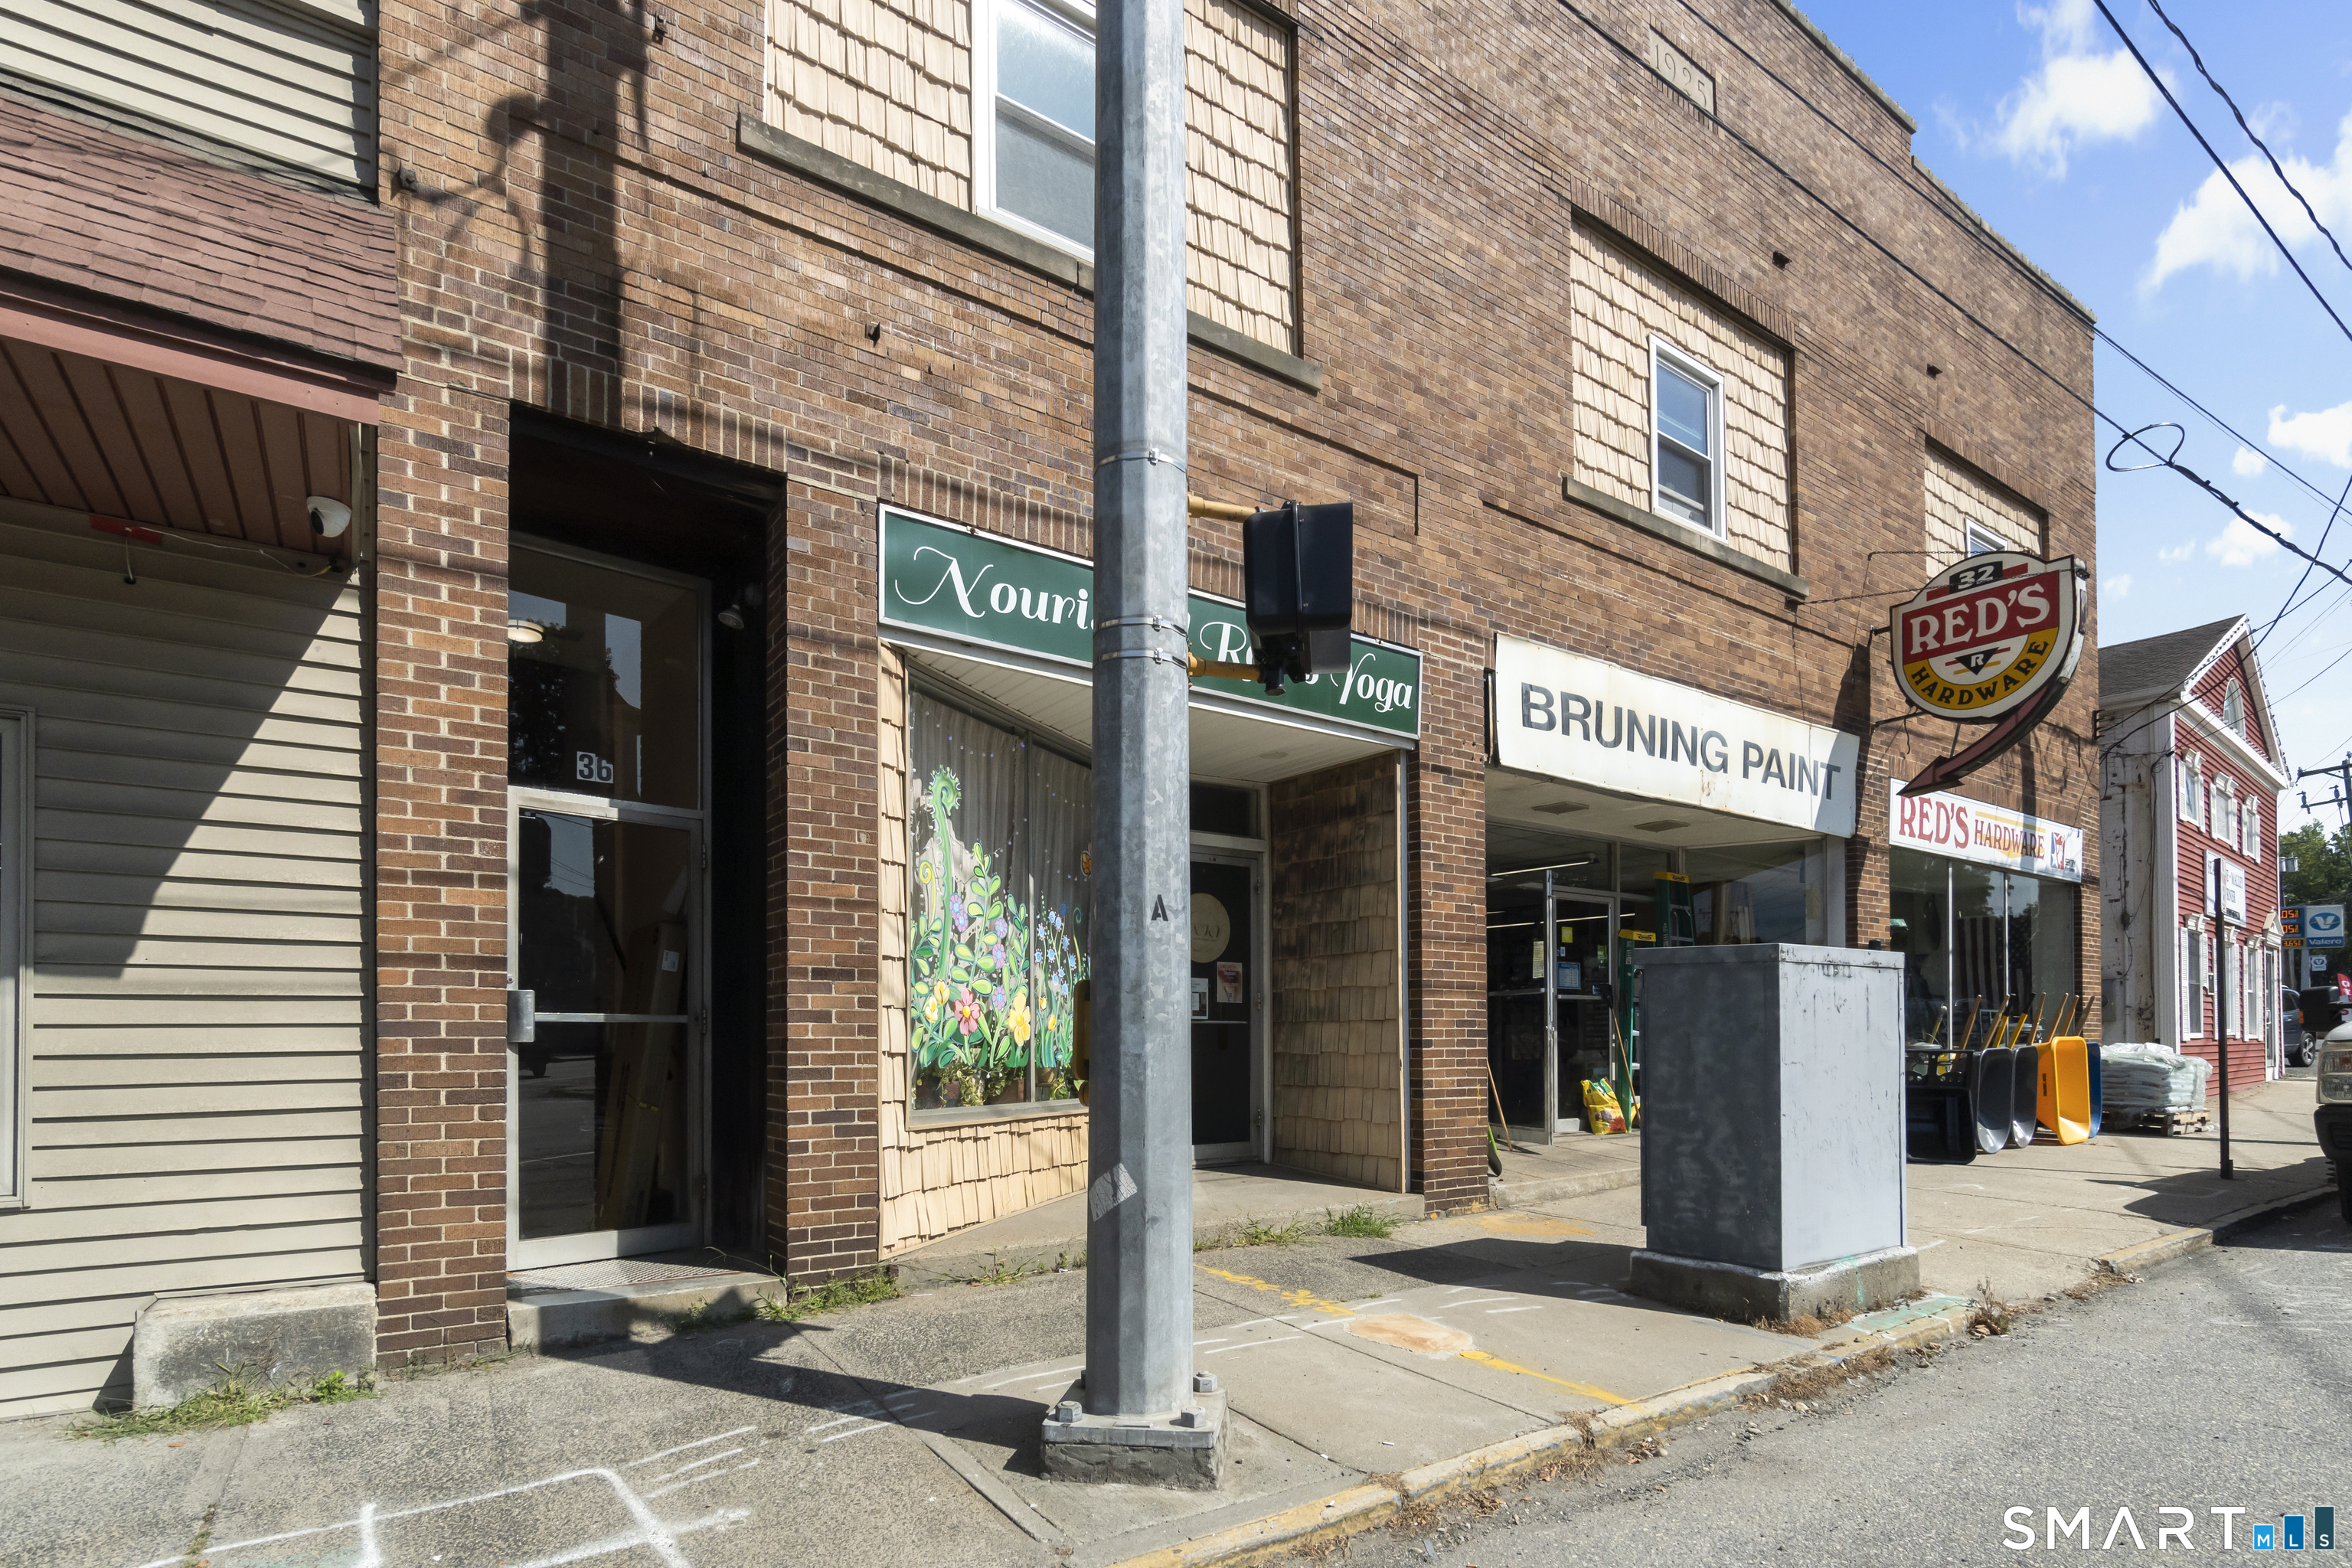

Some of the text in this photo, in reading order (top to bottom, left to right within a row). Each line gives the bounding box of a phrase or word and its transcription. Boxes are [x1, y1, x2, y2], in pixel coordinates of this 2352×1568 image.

[1655, 44, 1707, 108] 1925
[1958, 565, 1995, 590] 32
[894, 545, 1093, 630] Nouri
[1330, 652, 1413, 713] Yoga
[1909, 583, 2050, 655] RED'S
[1911, 640, 2050, 706] HARDWARE
[1970, 653, 1984, 668] R
[578, 753, 612, 782] 36
[1521, 681, 1841, 801] BRUNING PAINT
[1898, 795, 2045, 861] RED'S HARDWARE
[1151, 894, 1169, 922] A
